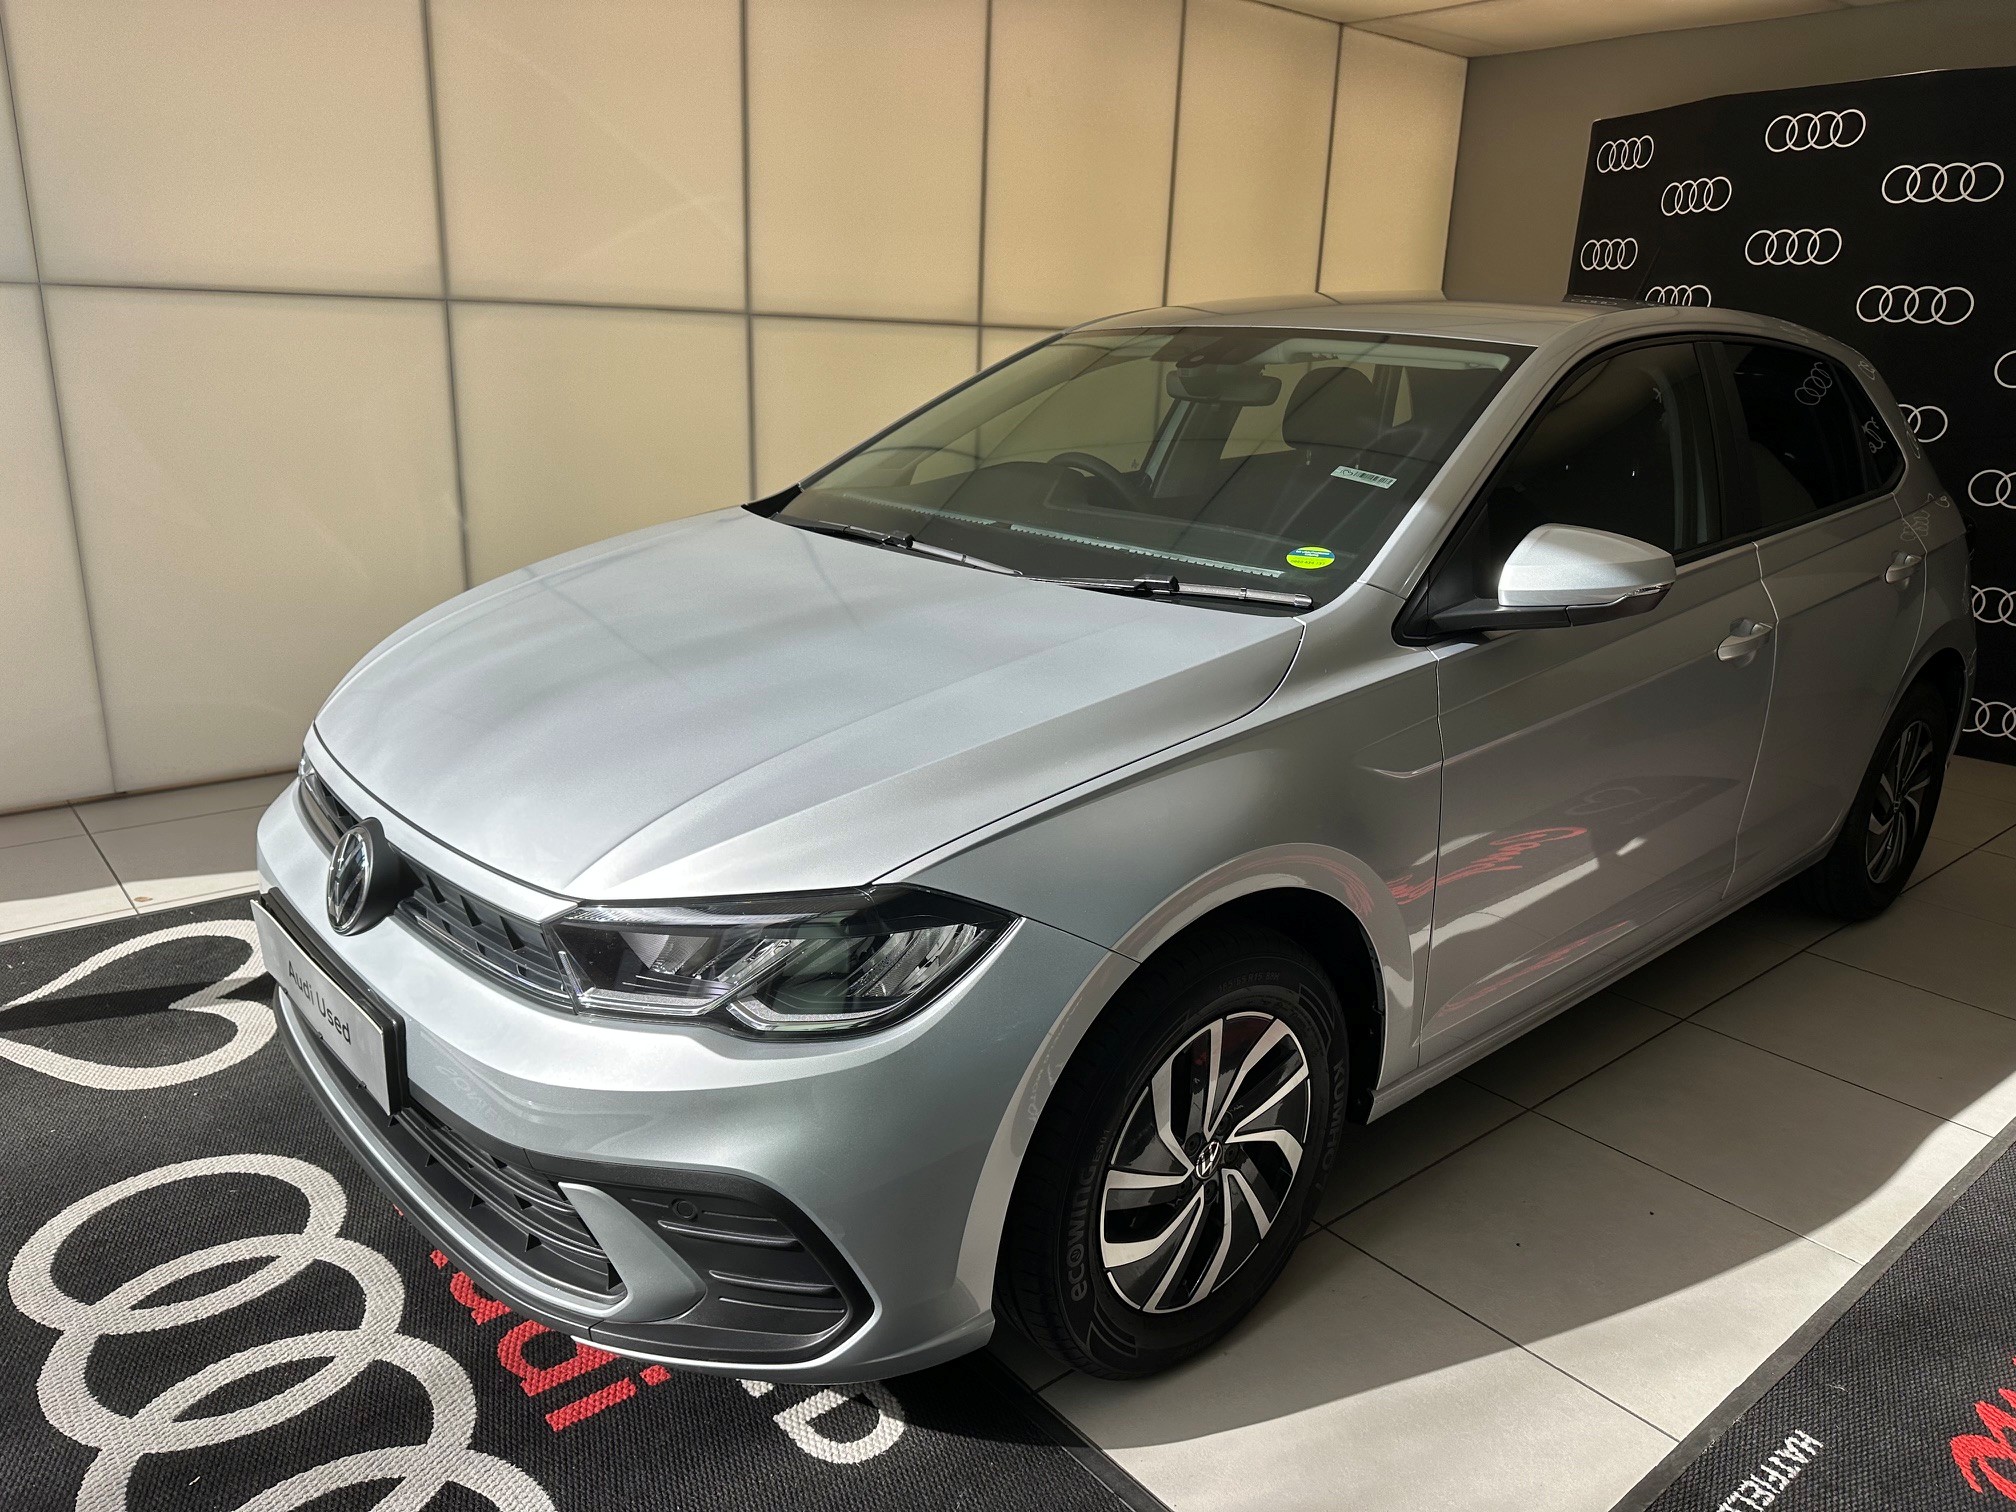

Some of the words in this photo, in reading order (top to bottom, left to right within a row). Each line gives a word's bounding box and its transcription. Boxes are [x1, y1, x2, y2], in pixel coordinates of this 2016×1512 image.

[288, 960, 315, 1006] Audi
[316, 991, 352, 1046] Used
[1322, 1057, 1345, 1171] KUMHO
